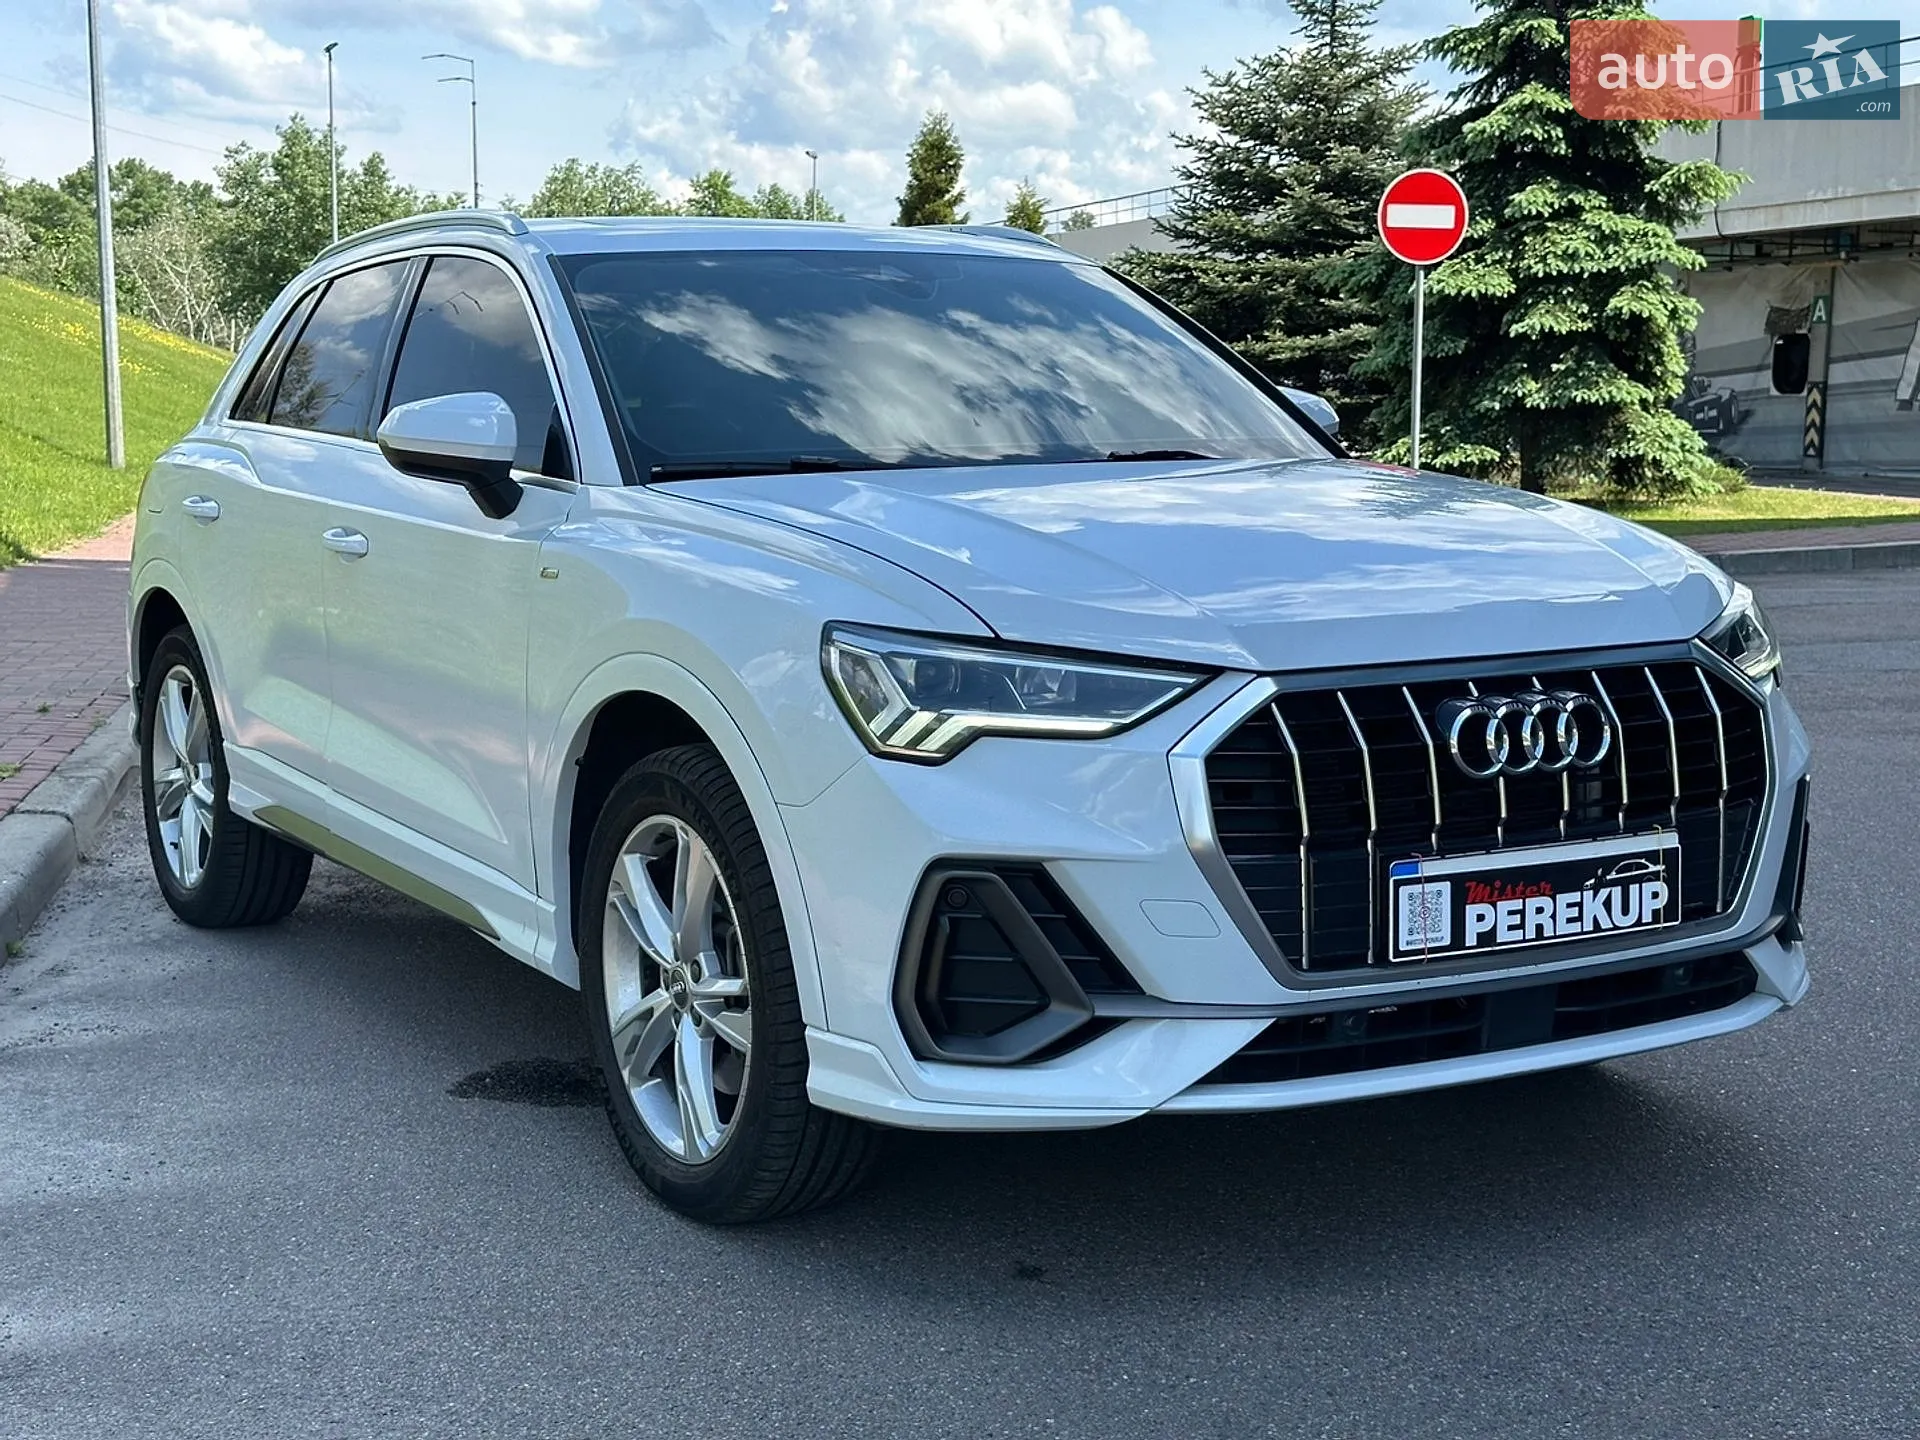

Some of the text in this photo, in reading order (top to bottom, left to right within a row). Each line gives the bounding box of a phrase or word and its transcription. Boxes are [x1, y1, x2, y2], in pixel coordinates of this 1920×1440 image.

[1812, 298, 1826, 321] A
[1465, 879, 1553, 904] Mister
[1465, 881, 1669, 947] PEREKUP
